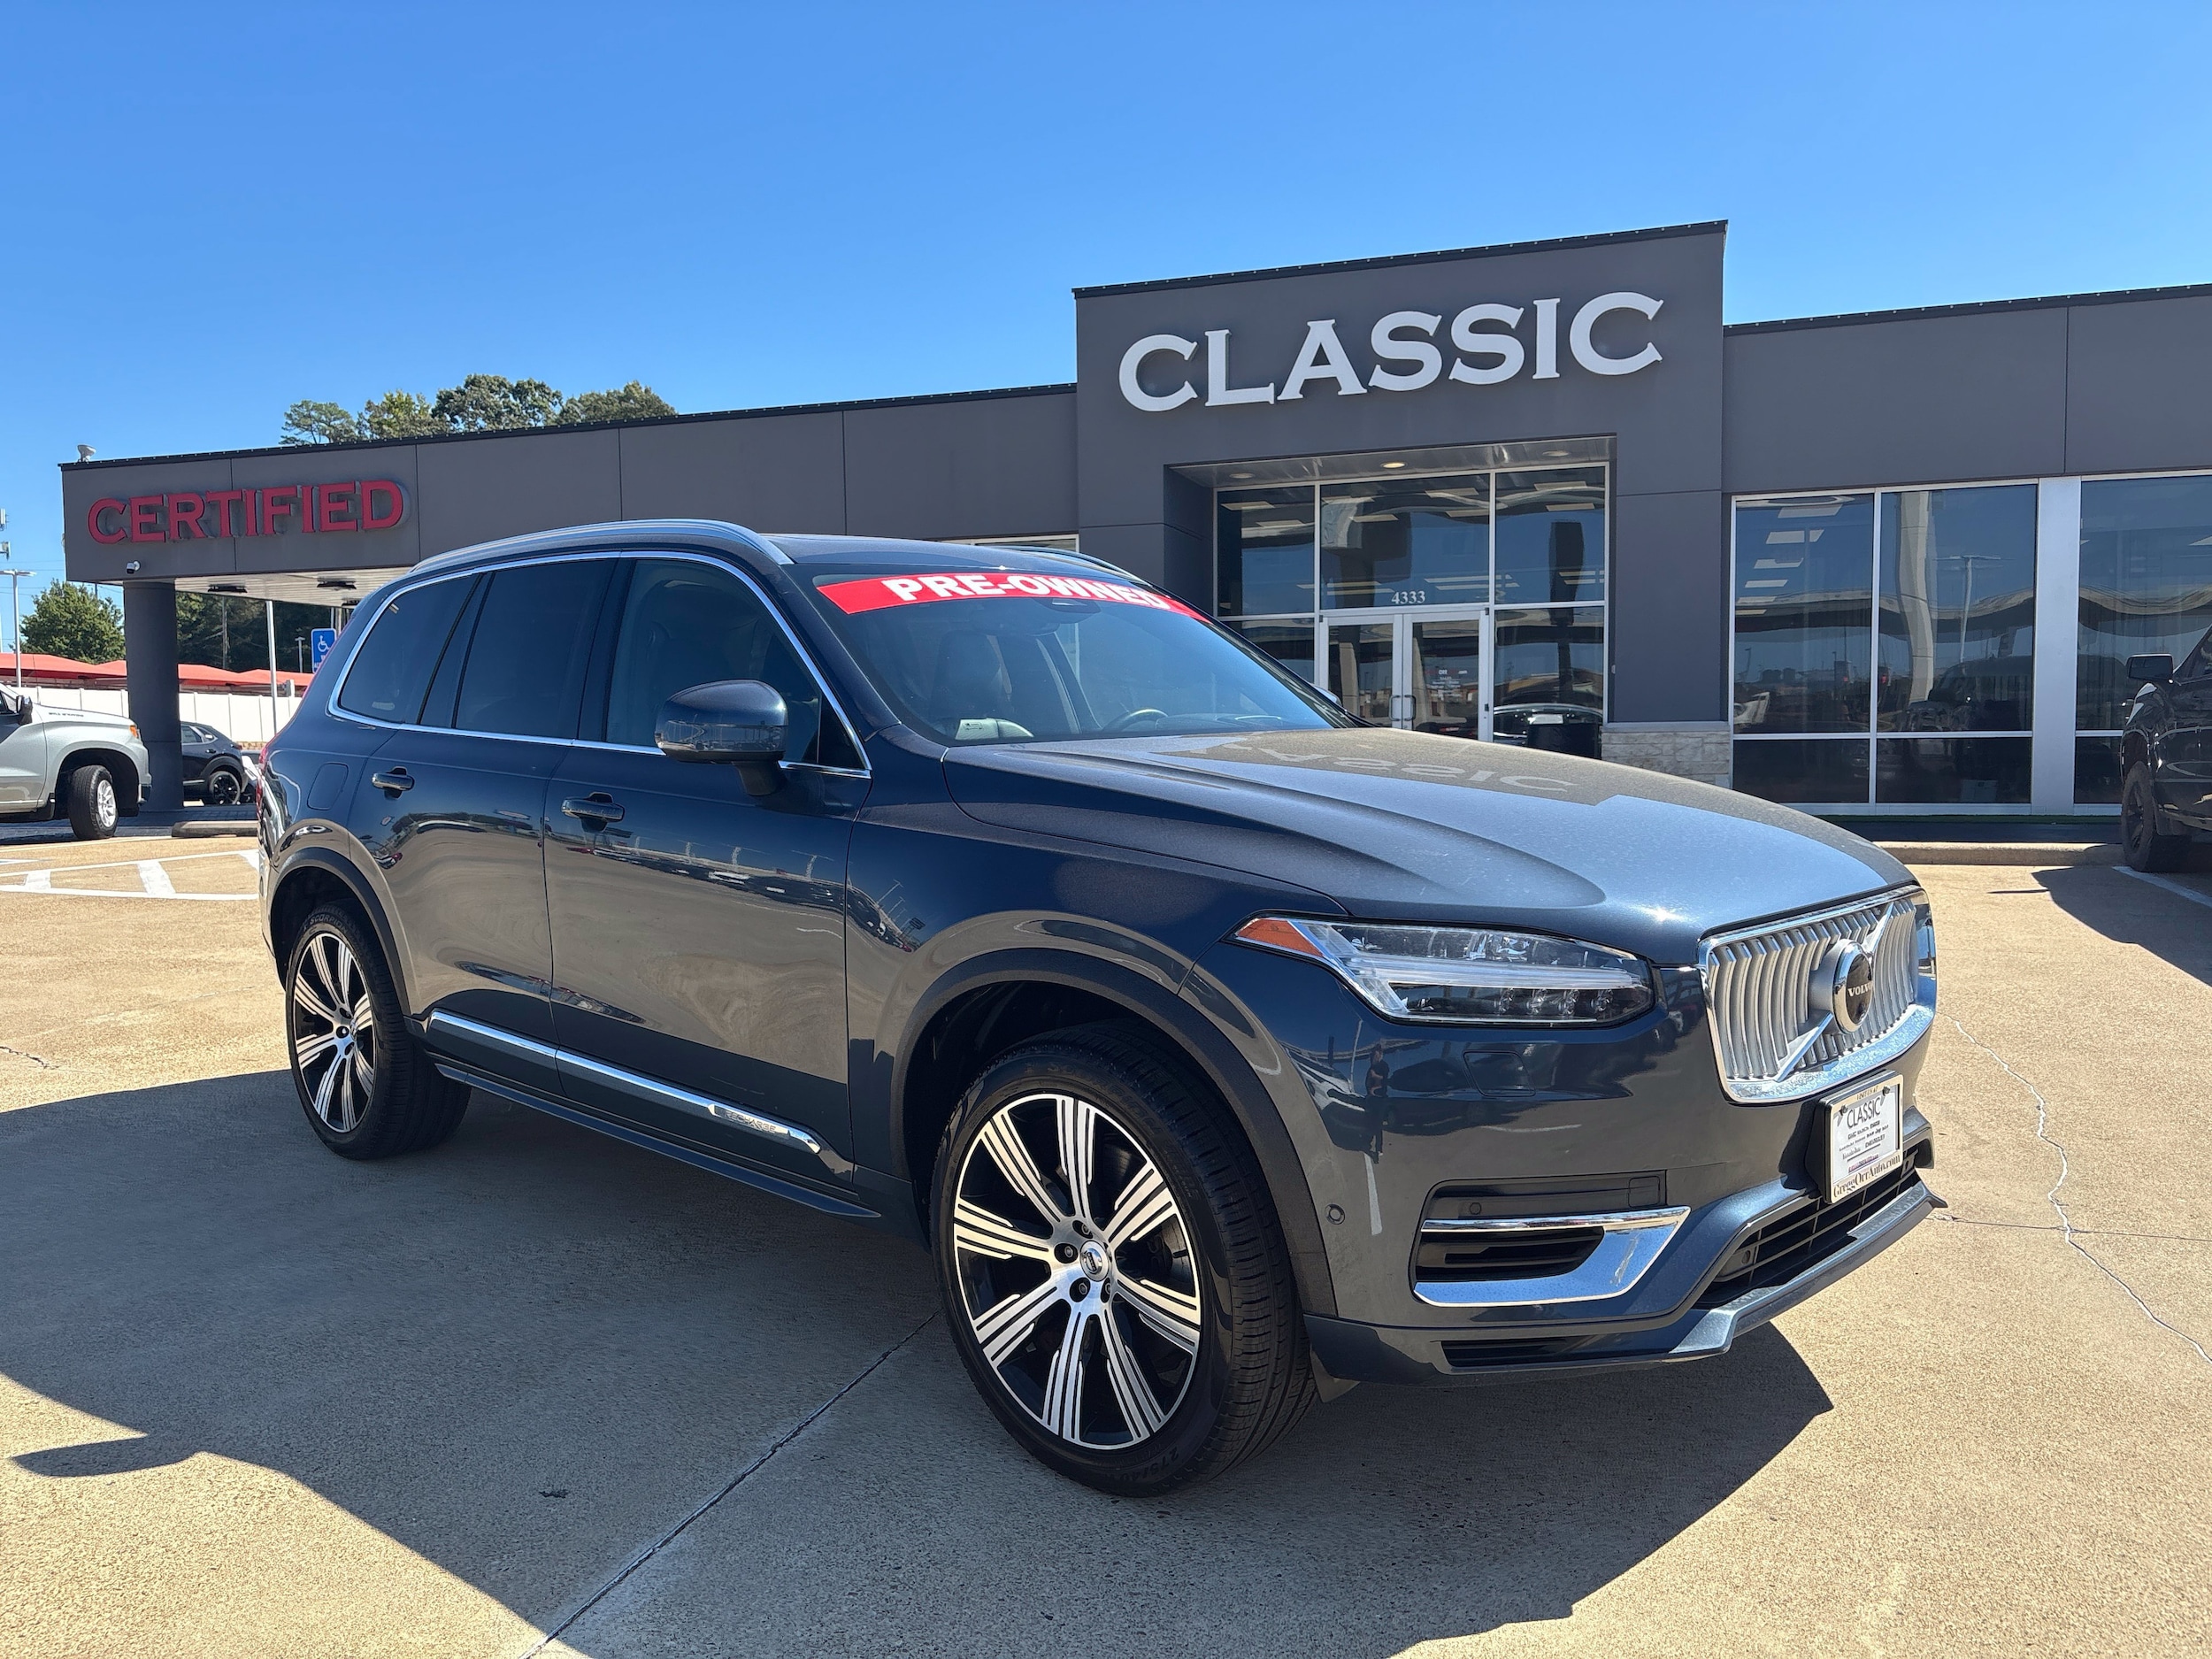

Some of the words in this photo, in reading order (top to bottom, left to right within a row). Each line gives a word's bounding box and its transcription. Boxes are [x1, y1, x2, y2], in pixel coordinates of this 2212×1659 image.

[1118, 291, 1664, 412] CLASSIC
[88, 480, 405, 545] CERTIFIED
[881, 574, 1172, 610] PRE-OWNED
[1391, 590, 1425, 604] 4333
[1847, 1096, 1881, 1129] CLASSIC
[1833, 1154, 1901, 1198] GreggOrrAuto.com
